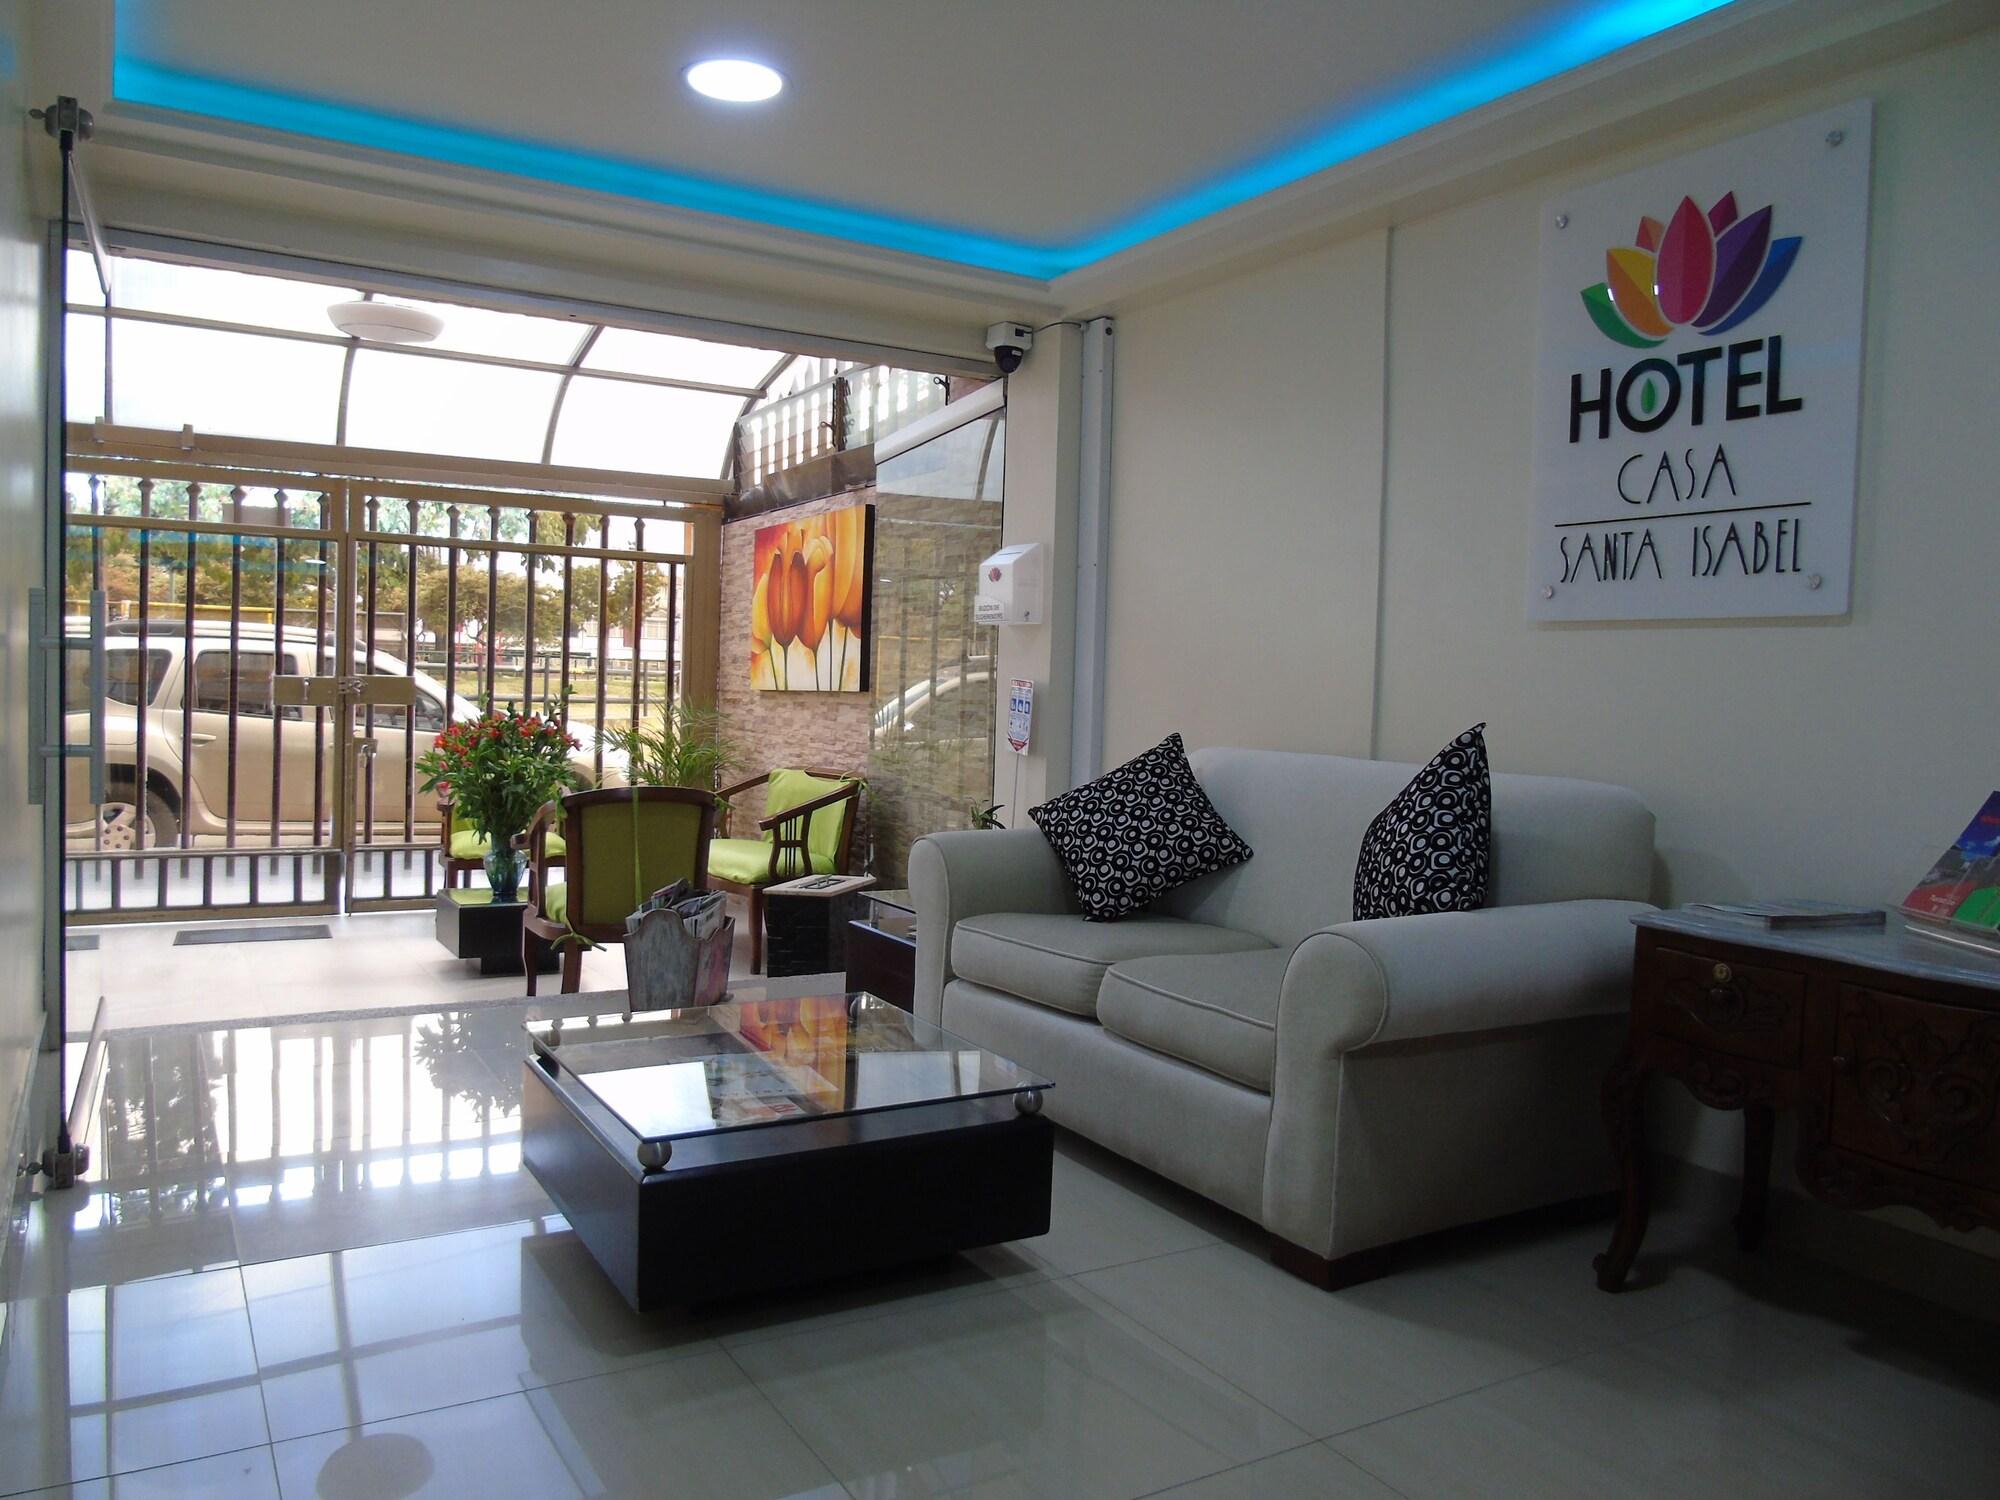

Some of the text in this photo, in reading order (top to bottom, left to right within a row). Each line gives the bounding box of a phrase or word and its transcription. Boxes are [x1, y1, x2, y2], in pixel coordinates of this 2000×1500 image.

[1569, 335, 1802, 443] HOTEL
[1617, 443, 1736, 504] CASA
[1560, 518, 1802, 583] SANTA ISABEL
